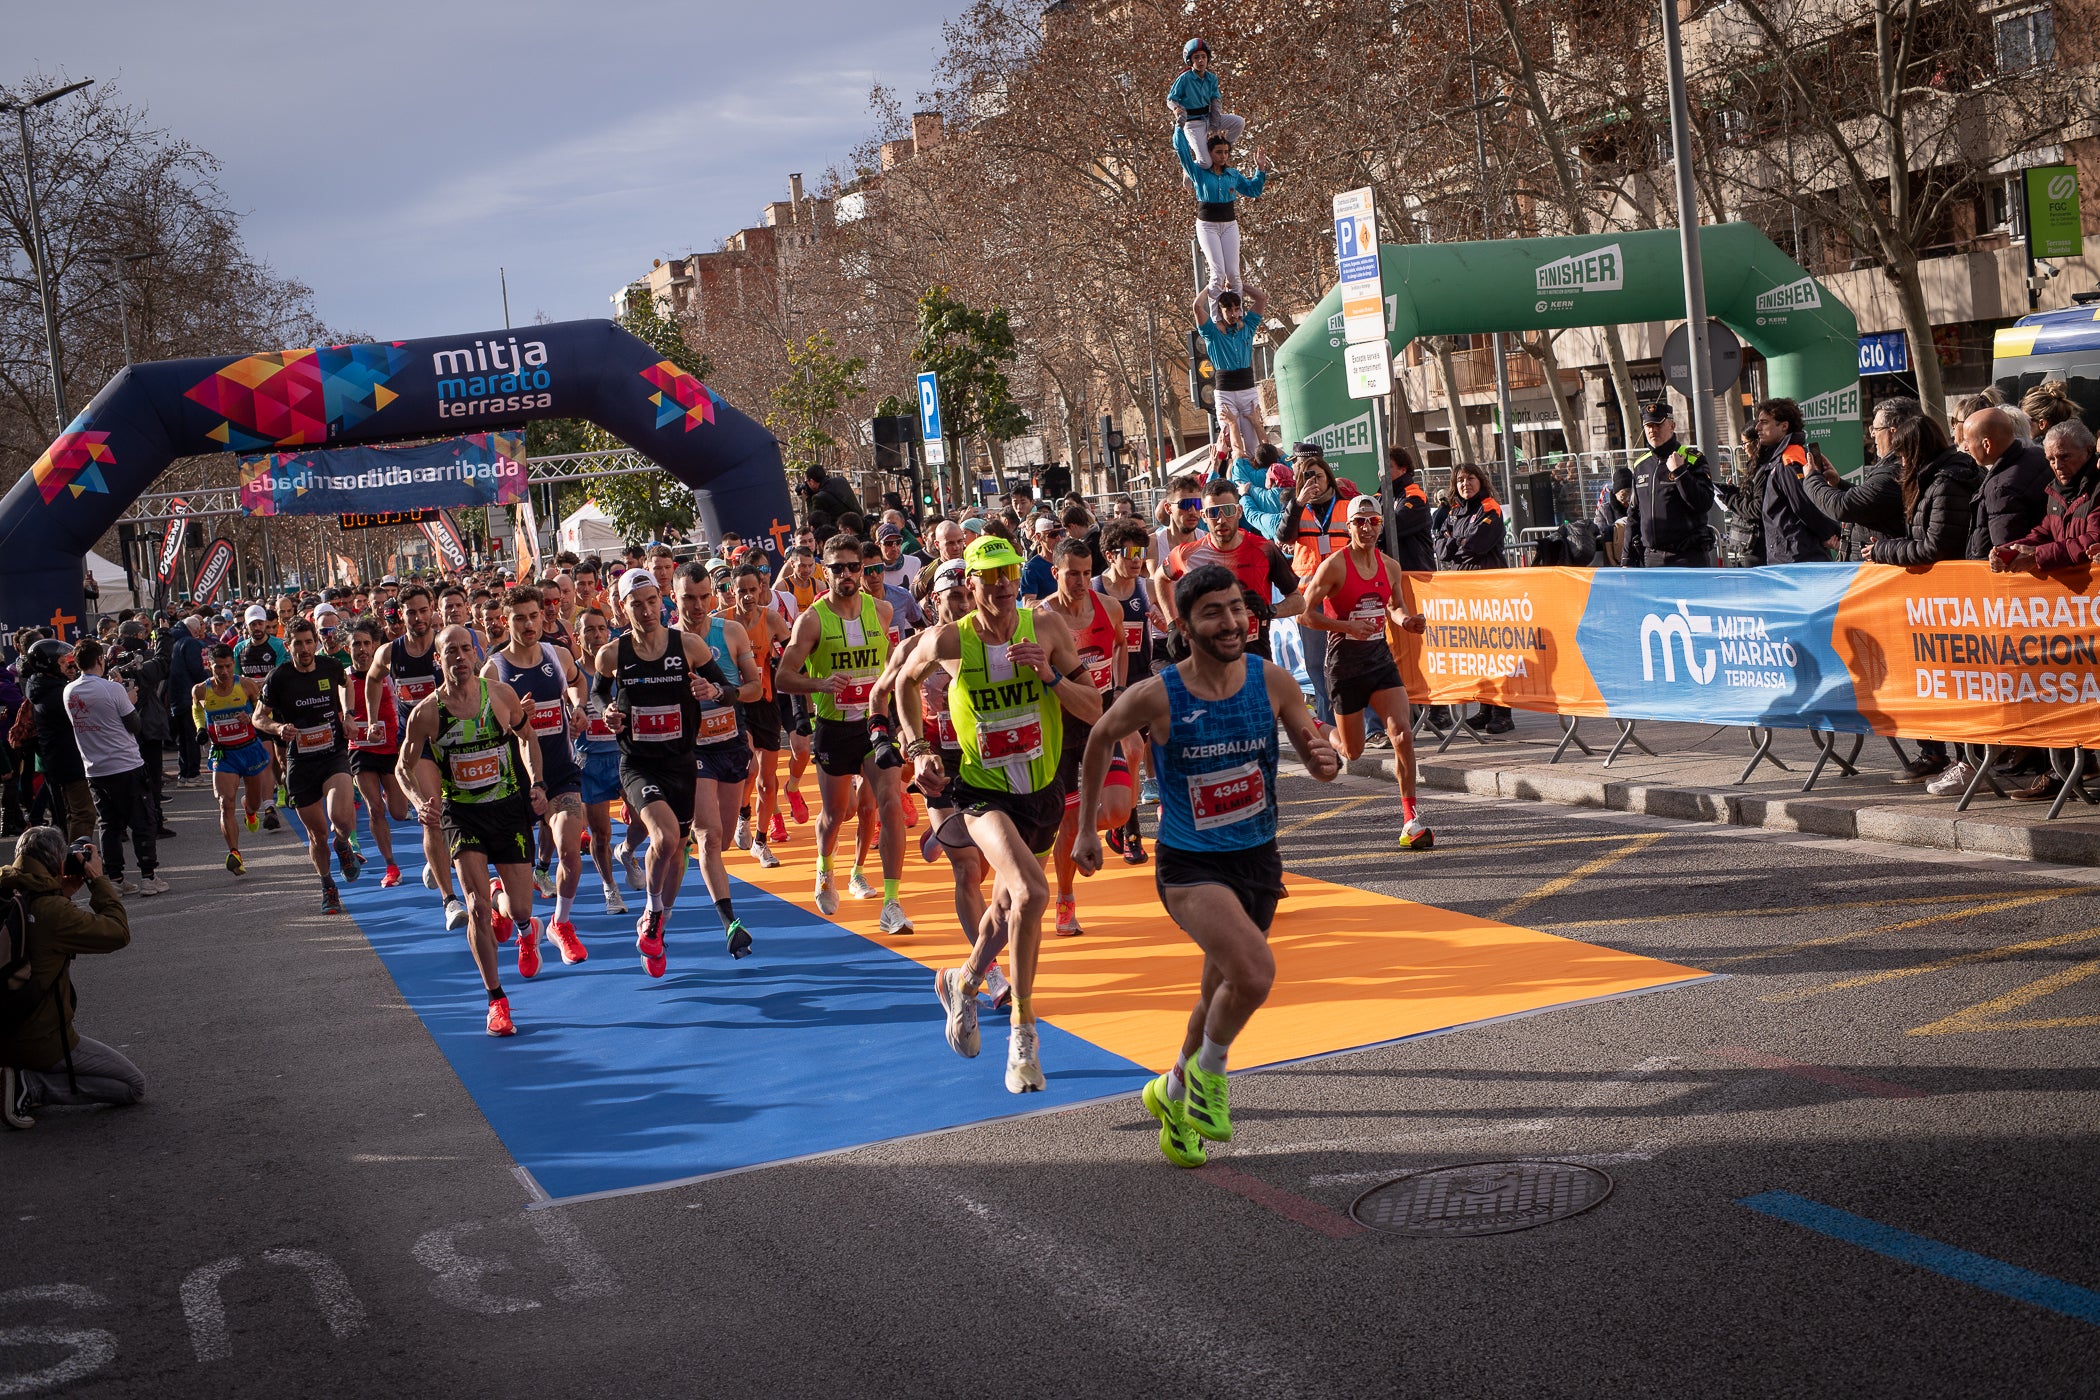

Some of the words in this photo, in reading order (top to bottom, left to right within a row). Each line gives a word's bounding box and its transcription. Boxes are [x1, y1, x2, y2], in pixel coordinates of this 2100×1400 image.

[2048, 202, 2067, 212] FGC
[1340, 221, 1352, 256] P
[1538, 252, 1616, 287] FINISHER
[1758, 282, 1816, 308] FINISHER
[432, 337, 548, 377] mitja
[437, 362, 551, 399] marató
[438, 393, 552, 418] terrassa
[920, 381, 934, 434] P
[420, 456, 519, 482] arribada
[984, 542, 1008, 554] IRWL
[194, 546, 228, 602] OQUENDO
[1422, 598, 1469, 623] MITJA
[1470, 592, 1533, 622] MARATÓ
[1906, 597, 1980, 628] MITJA
[1425, 624, 1546, 651] INTERNACIONAL
[1718, 616, 1768, 642] MITJA
[831, 648, 880, 670] IRWL
[1428, 655, 1446, 675] DE
[1448, 652, 1528, 678] TERRASSA
[1720, 636, 1798, 668] MARATÓ
[410, 684, 424, 693] 22
[855, 686, 863, 696] 9
[1724, 670, 1786, 689] TERRASSA
[1916, 668, 1948, 700] DE
[1951, 670, 2100, 704] TERRASSA
[296, 696, 330, 706] Collbaix
[968, 680, 1040, 712] IRWL
[650, 715, 665, 726] 11
[706, 715, 727, 728] 914
[1006, 730, 1019, 743] 3
[1182, 737, 1267, 760] AZERBAIJAN
[462, 763, 492, 778] 1612
[1214, 780, 1249, 798] 4345
